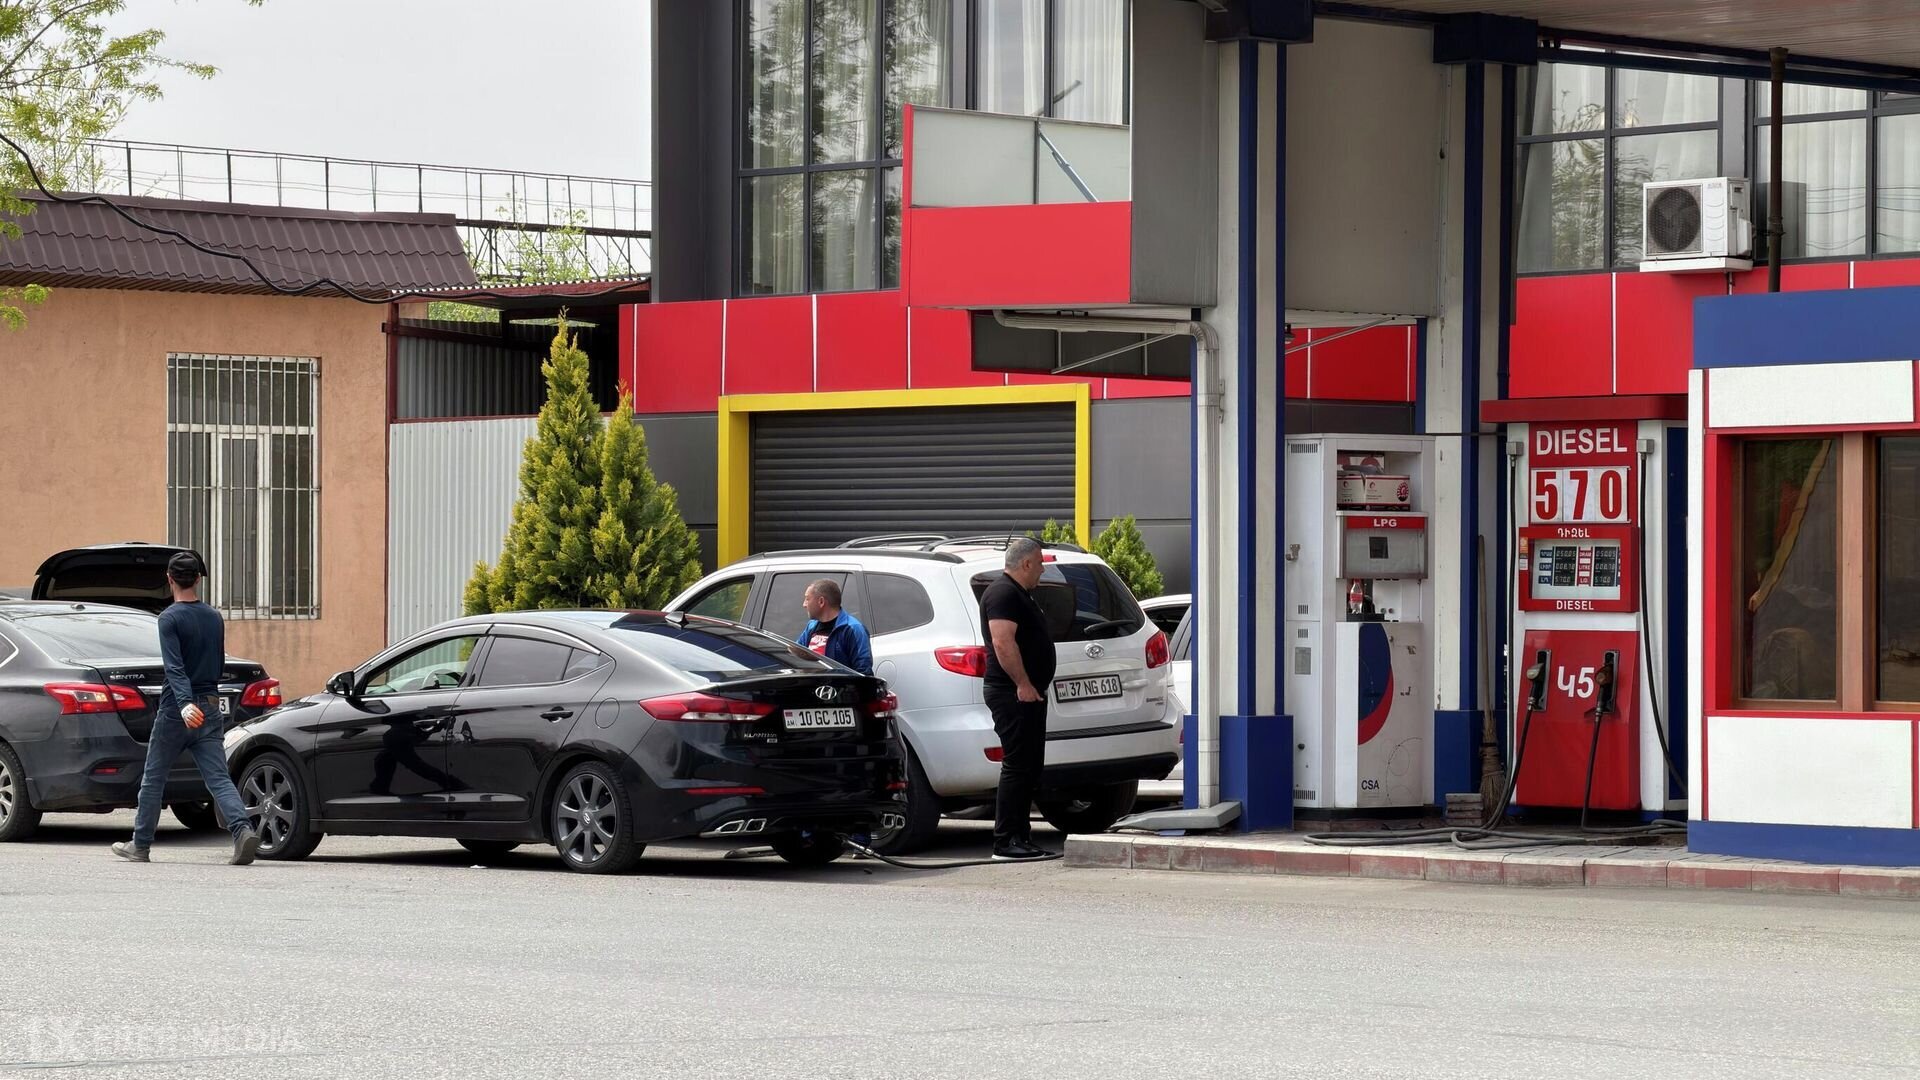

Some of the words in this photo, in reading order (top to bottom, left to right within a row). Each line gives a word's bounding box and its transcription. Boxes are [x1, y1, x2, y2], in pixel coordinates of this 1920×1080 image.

[1536, 428, 1628, 456] DIESEL
[1535, 470, 1622, 520] 570
[1373, 518, 1397, 528] LPG
[1557, 528, 1590, 538] ԴԻԶԵԼ
[1556, 600, 1594, 610] DIESEL
[109, 673, 145, 681] SENTRA
[1069, 682, 1081, 697] 37
[1085, 680, 1099, 696] NG
[1101, 678, 1118, 693] 618
[800, 711, 812, 726] 10
[815, 710, 831, 726] GC
[834, 709, 852, 725] 105
[1361, 779, 1380, 790] CSA
